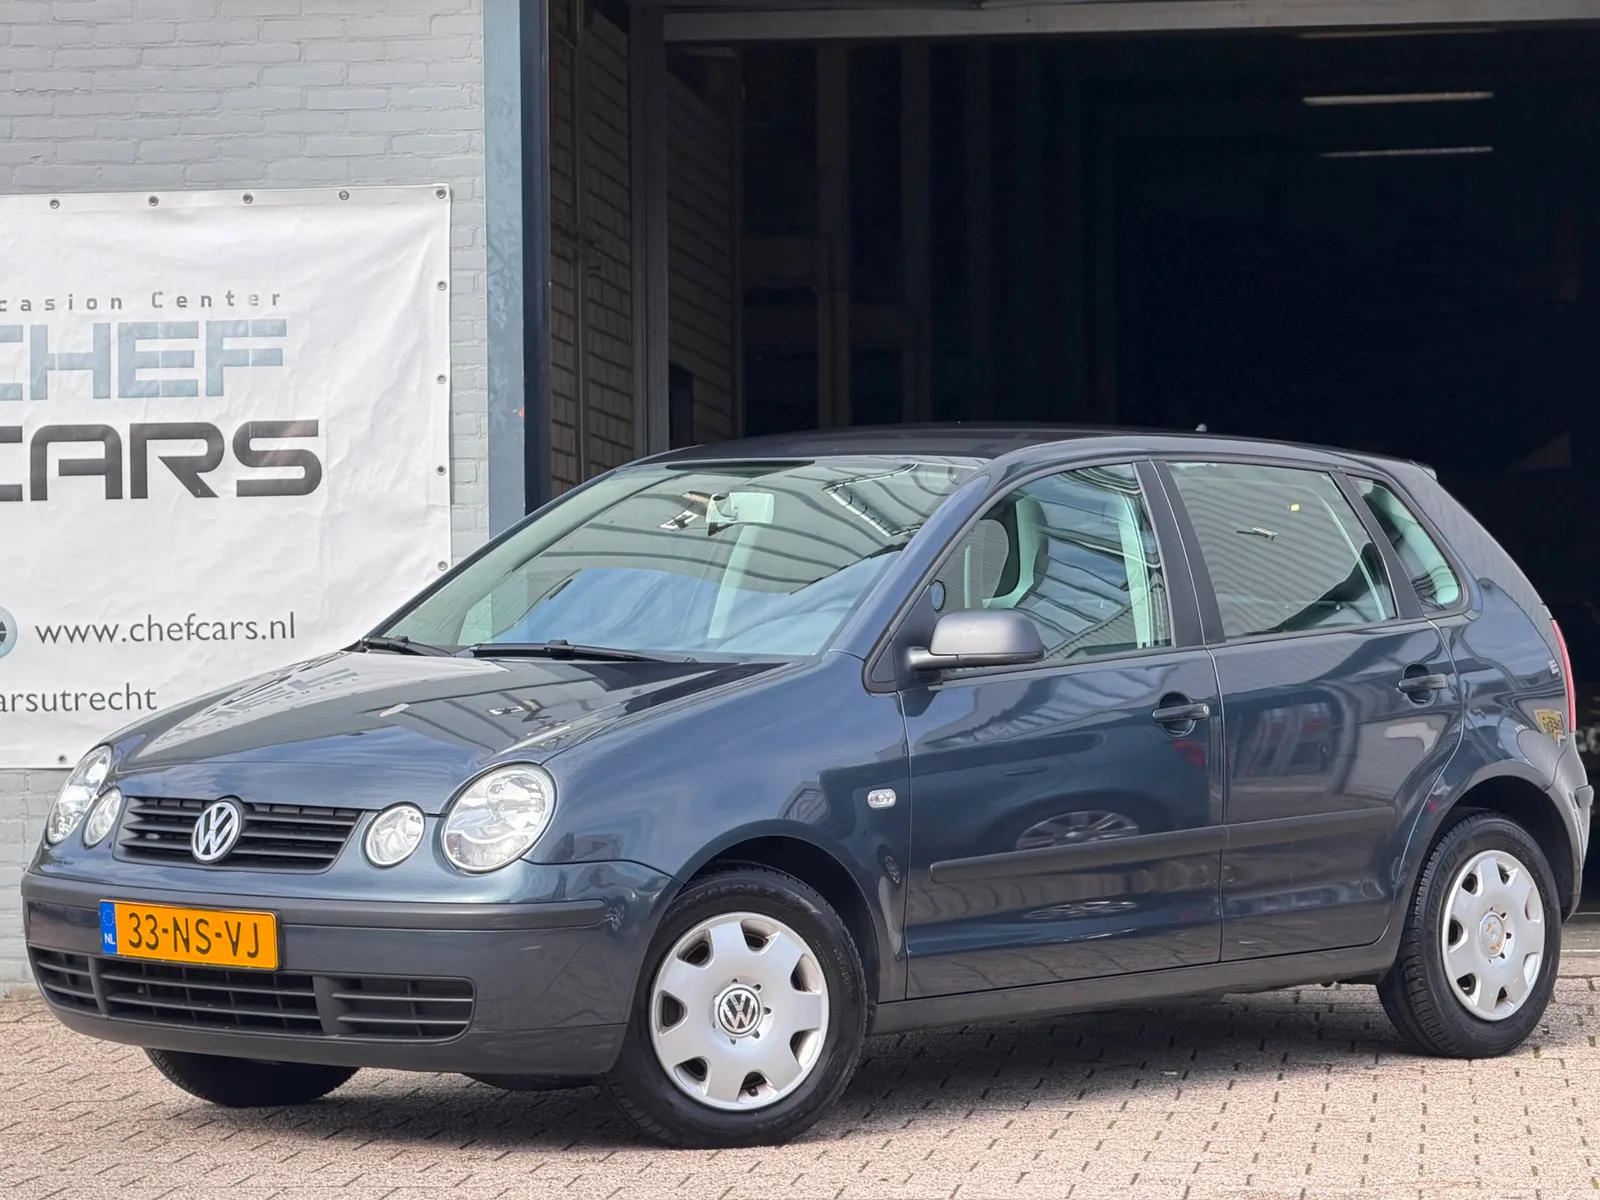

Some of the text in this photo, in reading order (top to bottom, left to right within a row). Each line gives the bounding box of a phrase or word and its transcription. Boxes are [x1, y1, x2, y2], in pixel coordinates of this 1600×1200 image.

[152, 290, 281, 309] Center
[35, 611, 296, 644] www.chefcars.nl
[104, 932, 116, 945] NL
[128, 912, 260, 959] 33-NS-VJ
